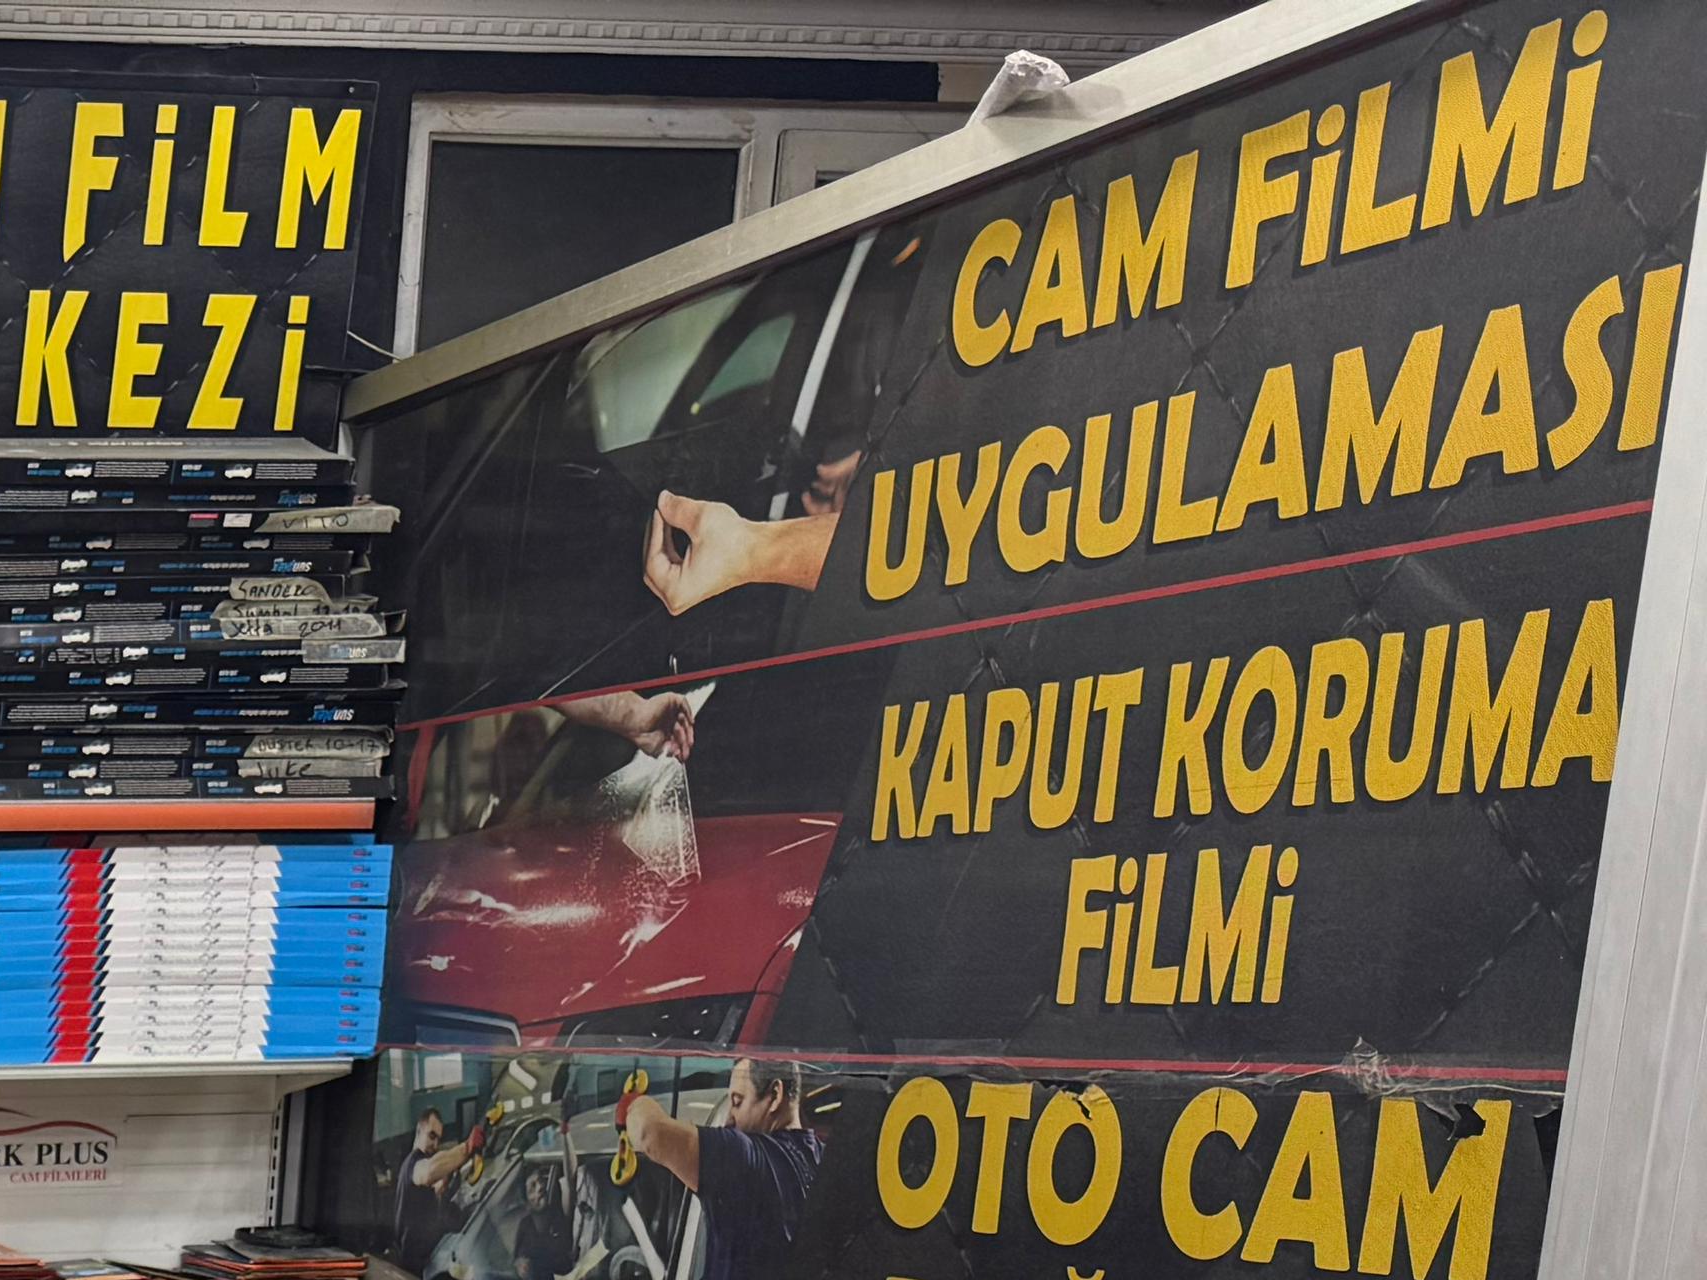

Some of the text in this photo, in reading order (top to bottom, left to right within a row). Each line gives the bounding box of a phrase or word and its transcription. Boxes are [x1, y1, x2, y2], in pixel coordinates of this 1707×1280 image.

[955, 153, 1198, 366] CAM
[868, 267, 1683, 600] UYGULAMASI
[282, 513, 349, 529] VITO
[872, 600, 1619, 841] KAPUT KORUMA
[10, 1171, 39, 1184] CAM
[37, 1141, 108, 1166] PLUS
[876, 1077, 1124, 1247] OTO
